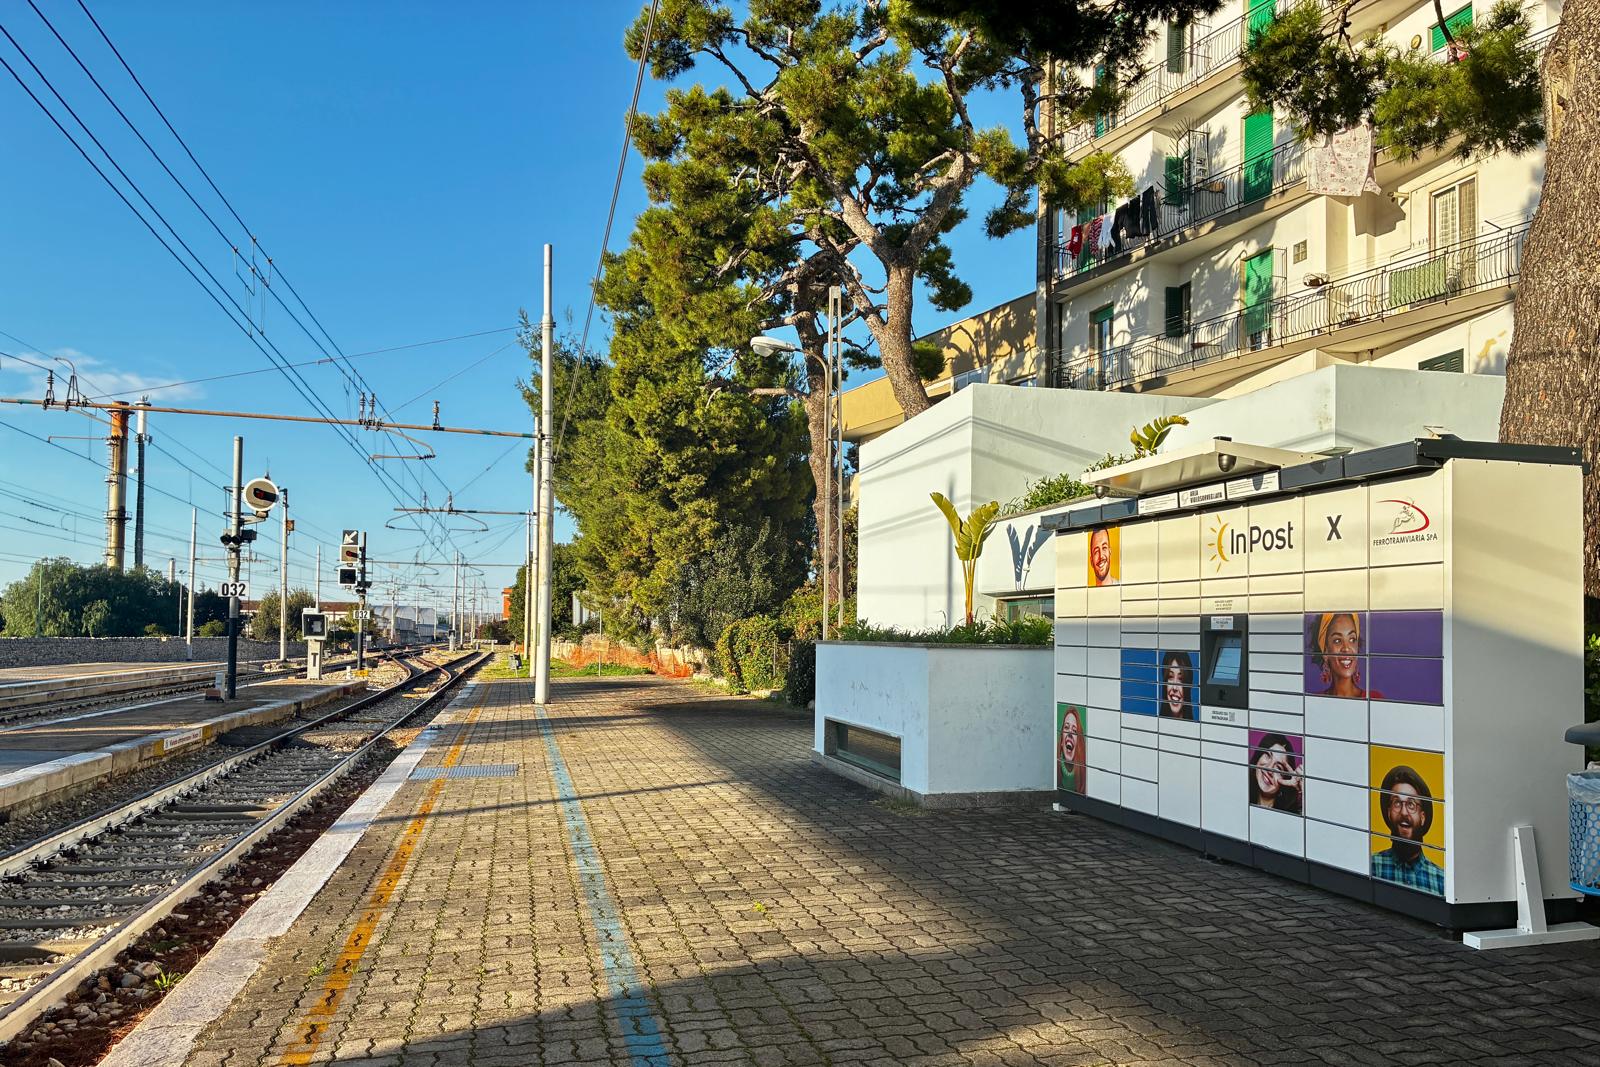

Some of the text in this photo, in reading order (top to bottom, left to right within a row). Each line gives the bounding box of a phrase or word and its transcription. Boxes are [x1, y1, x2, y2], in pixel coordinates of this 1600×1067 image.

[1326, 514, 1342, 541] X
[1230, 521, 1294, 555] InPost
[1373, 534, 1425, 546] FERROTRAMVIARIA
[221, 583, 246, 597] 032
[354, 610, 368, 619] 032
